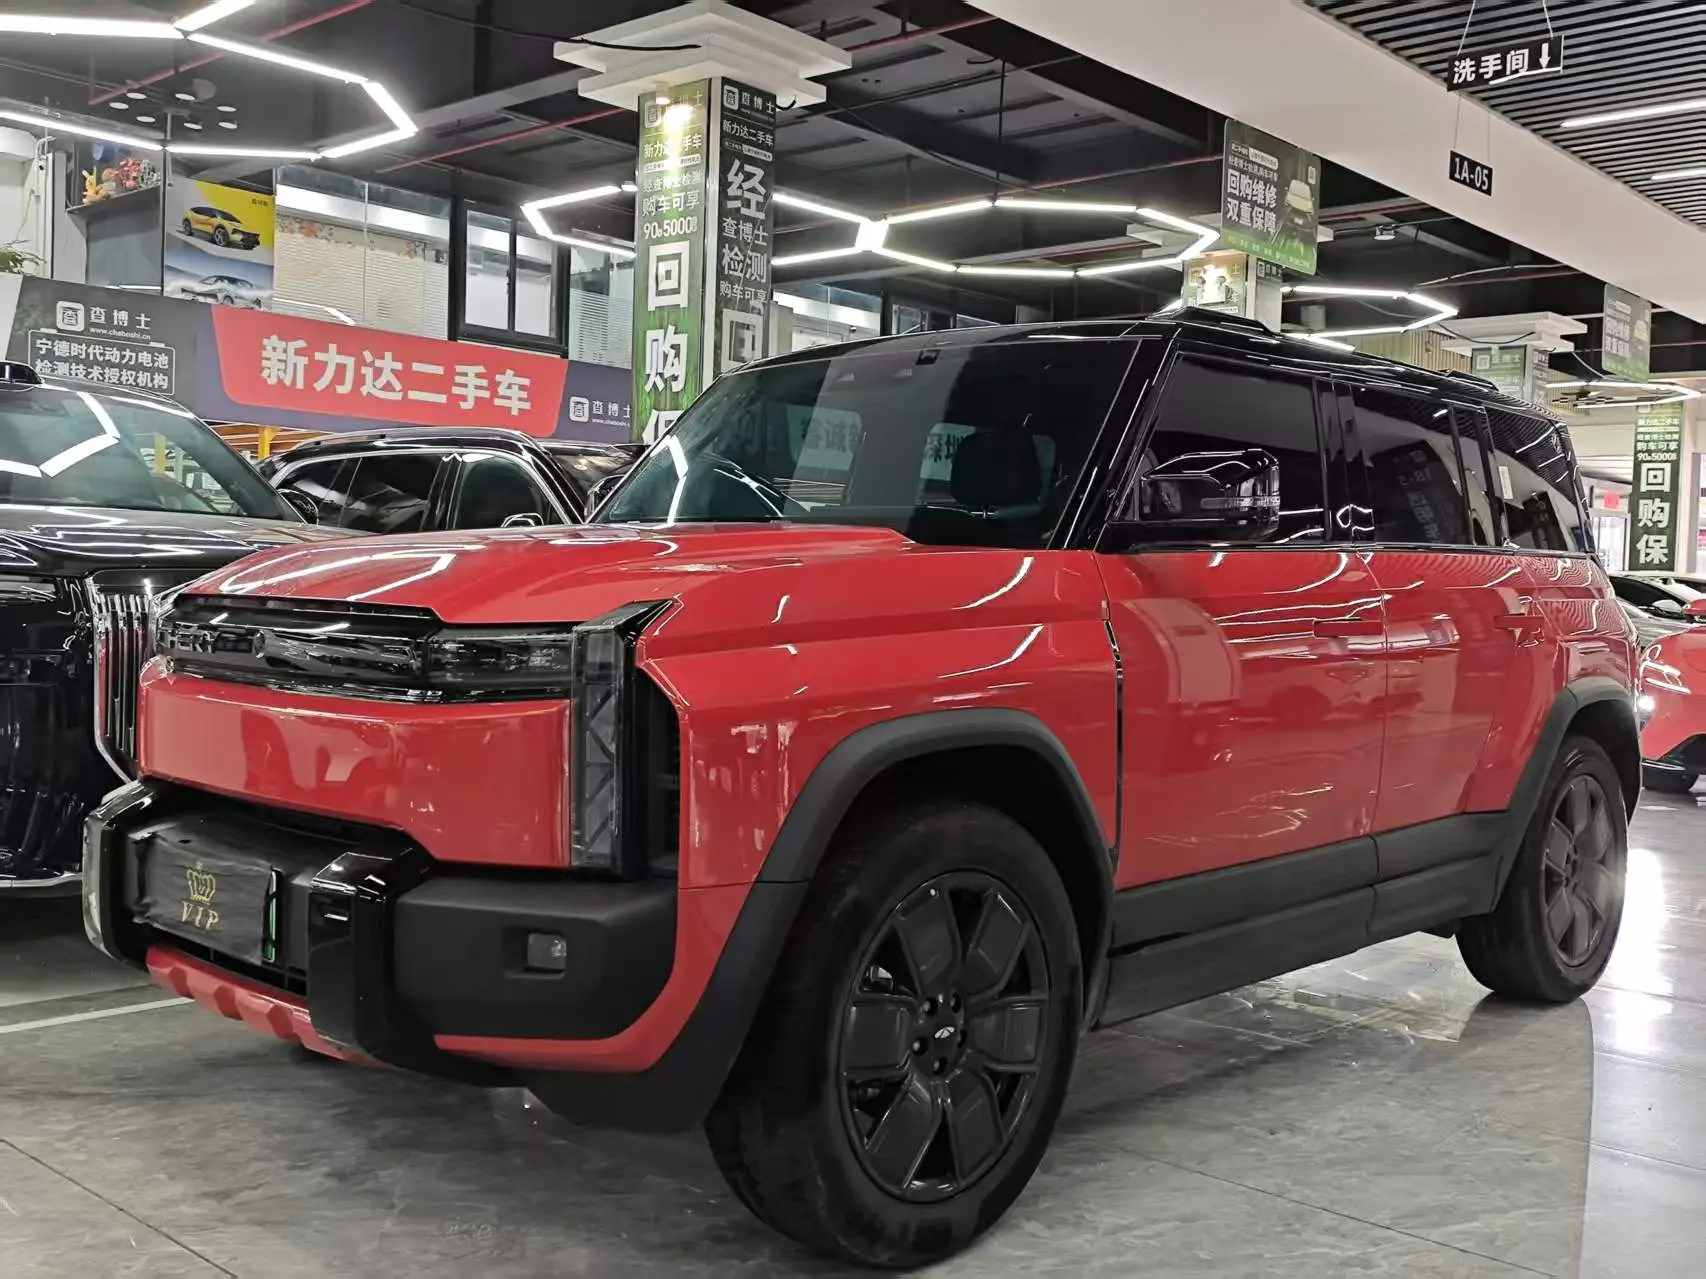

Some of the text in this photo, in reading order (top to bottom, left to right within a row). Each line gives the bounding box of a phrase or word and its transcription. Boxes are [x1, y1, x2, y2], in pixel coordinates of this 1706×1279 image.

[1453, 48, 1530, 84] 洗手间
[644, 134, 702, 159] 新力手车
[722, 119, 774, 147] 新力达二手车
[727, 158, 767, 220] 经
[1227, 168, 1278, 208] 回购维修
[1454, 157, 1489, 191] 1A-05
[642, 190, 700, 217] 购车可享
[1226, 197, 1278, 235] 双重保障
[722, 216, 769, 246] 查博士
[722, 243, 768, 283] 检测
[719, 280, 768, 303] 购车可享
[90, 306, 151, 330] 查博士
[90, 326, 151, 340] www.chaboshi.cn
[35, 337, 169, 370] 宁德时代动力电池
[35, 358, 169, 390] 检测技术授权机构
[260, 334, 531, 416] 新力达二手车
[1635, 463, 1673, 565] 回购保
[181, 901, 219, 930] VIP
